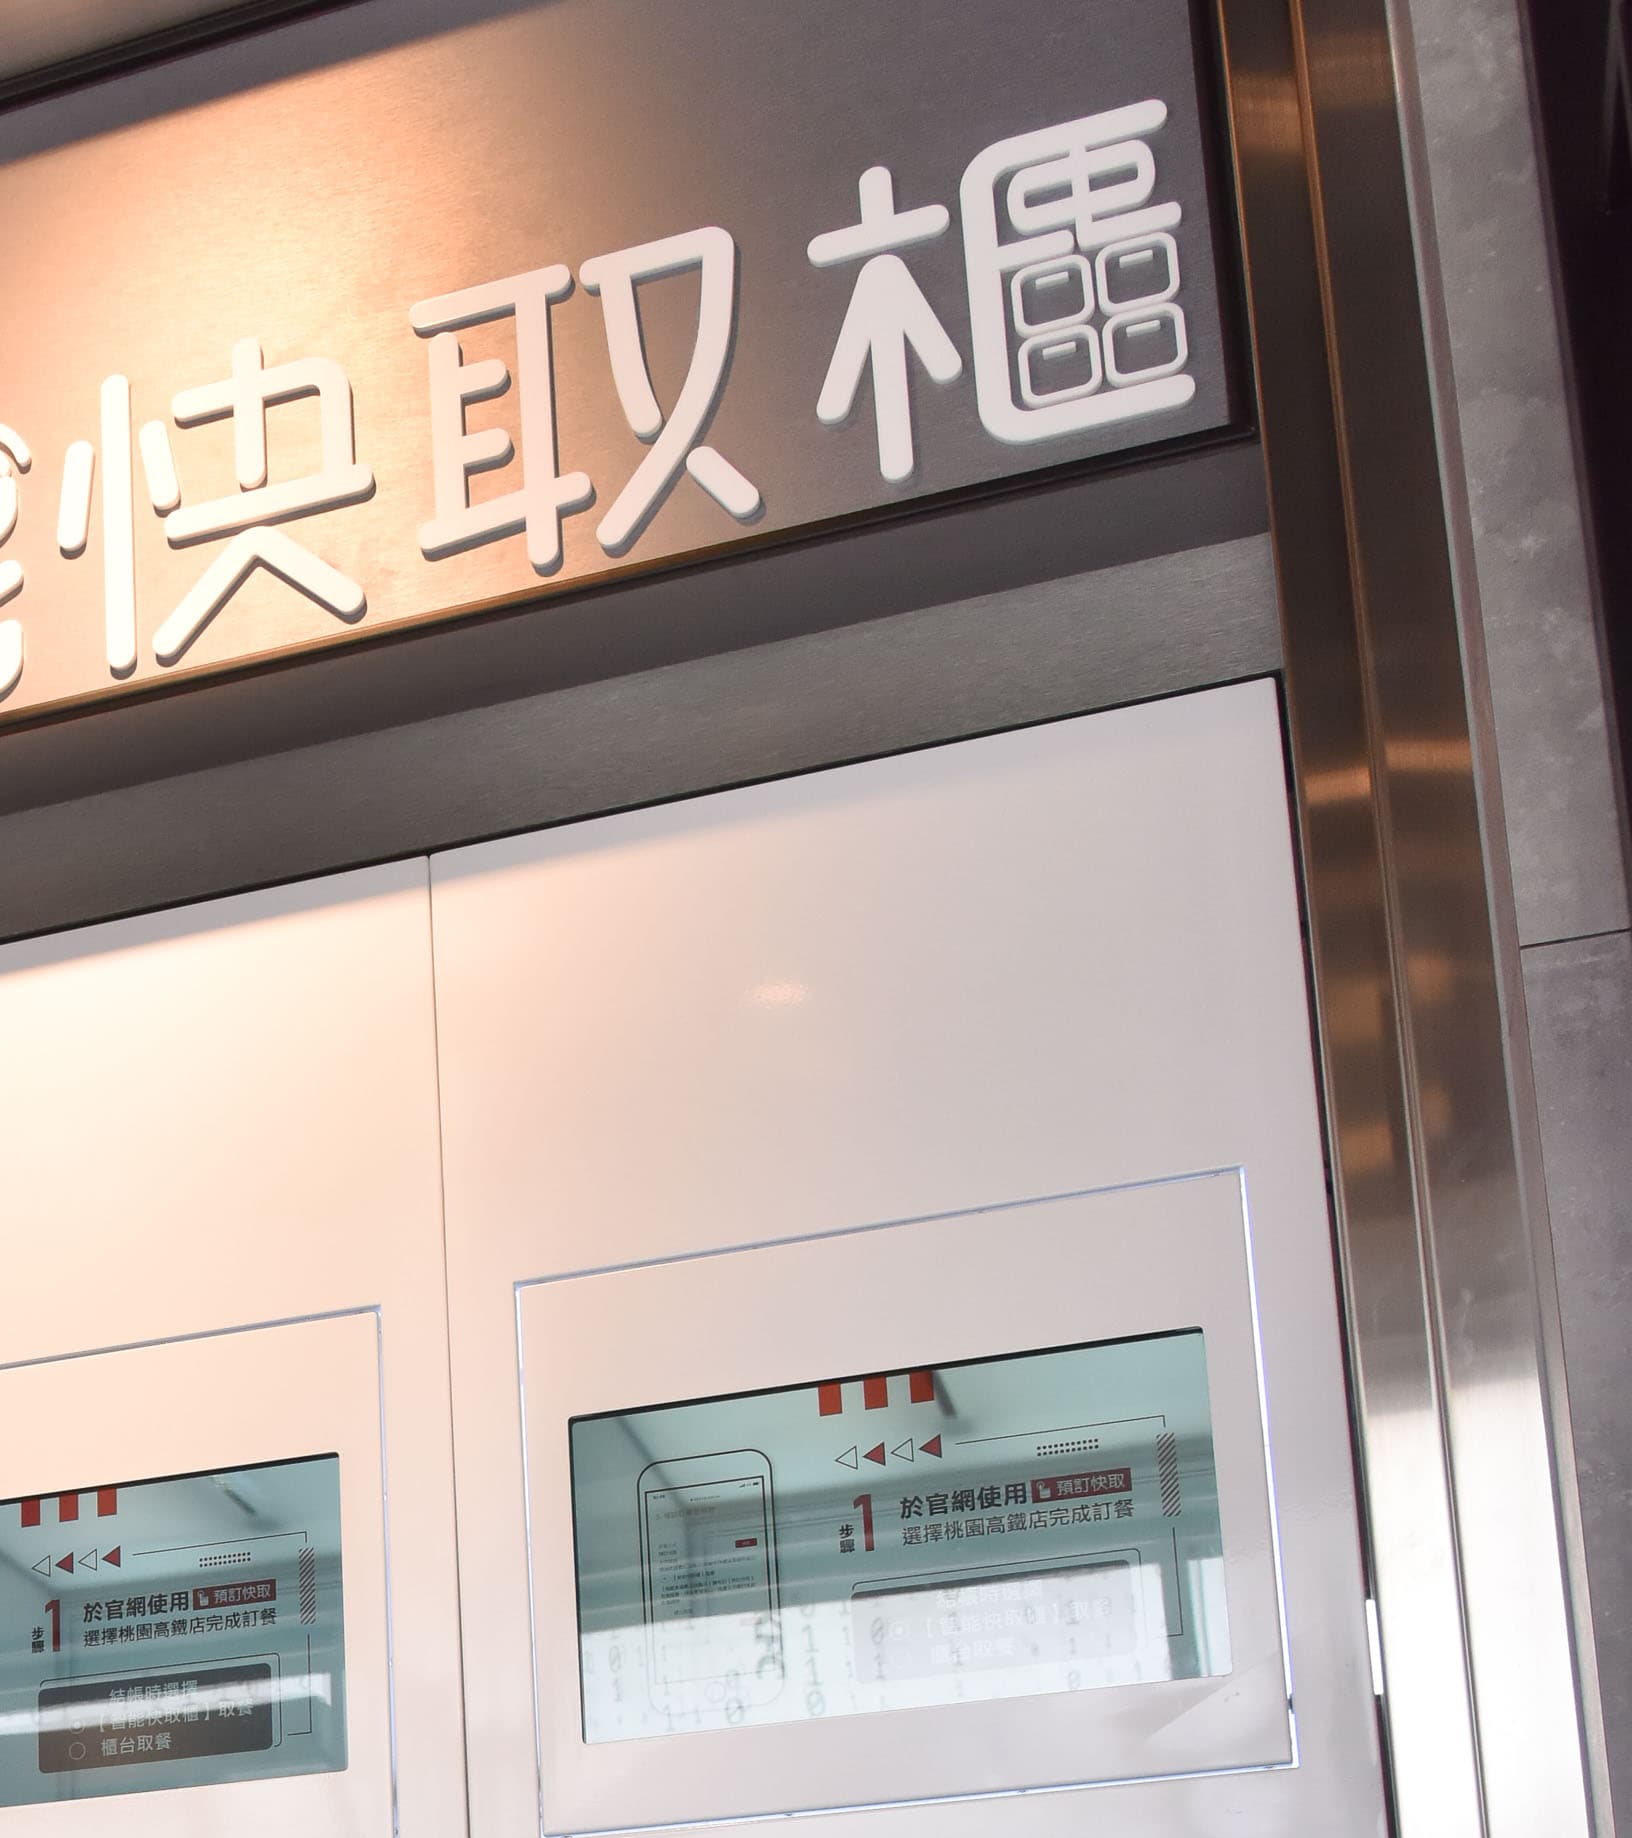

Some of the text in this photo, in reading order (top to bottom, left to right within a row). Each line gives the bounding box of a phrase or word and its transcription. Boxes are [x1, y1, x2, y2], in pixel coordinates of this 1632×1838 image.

[900, 1473, 1126, 1519] 於官網使用 預訂快取
[84, 1584, 271, 1623] 於官網使用 預訂快取
